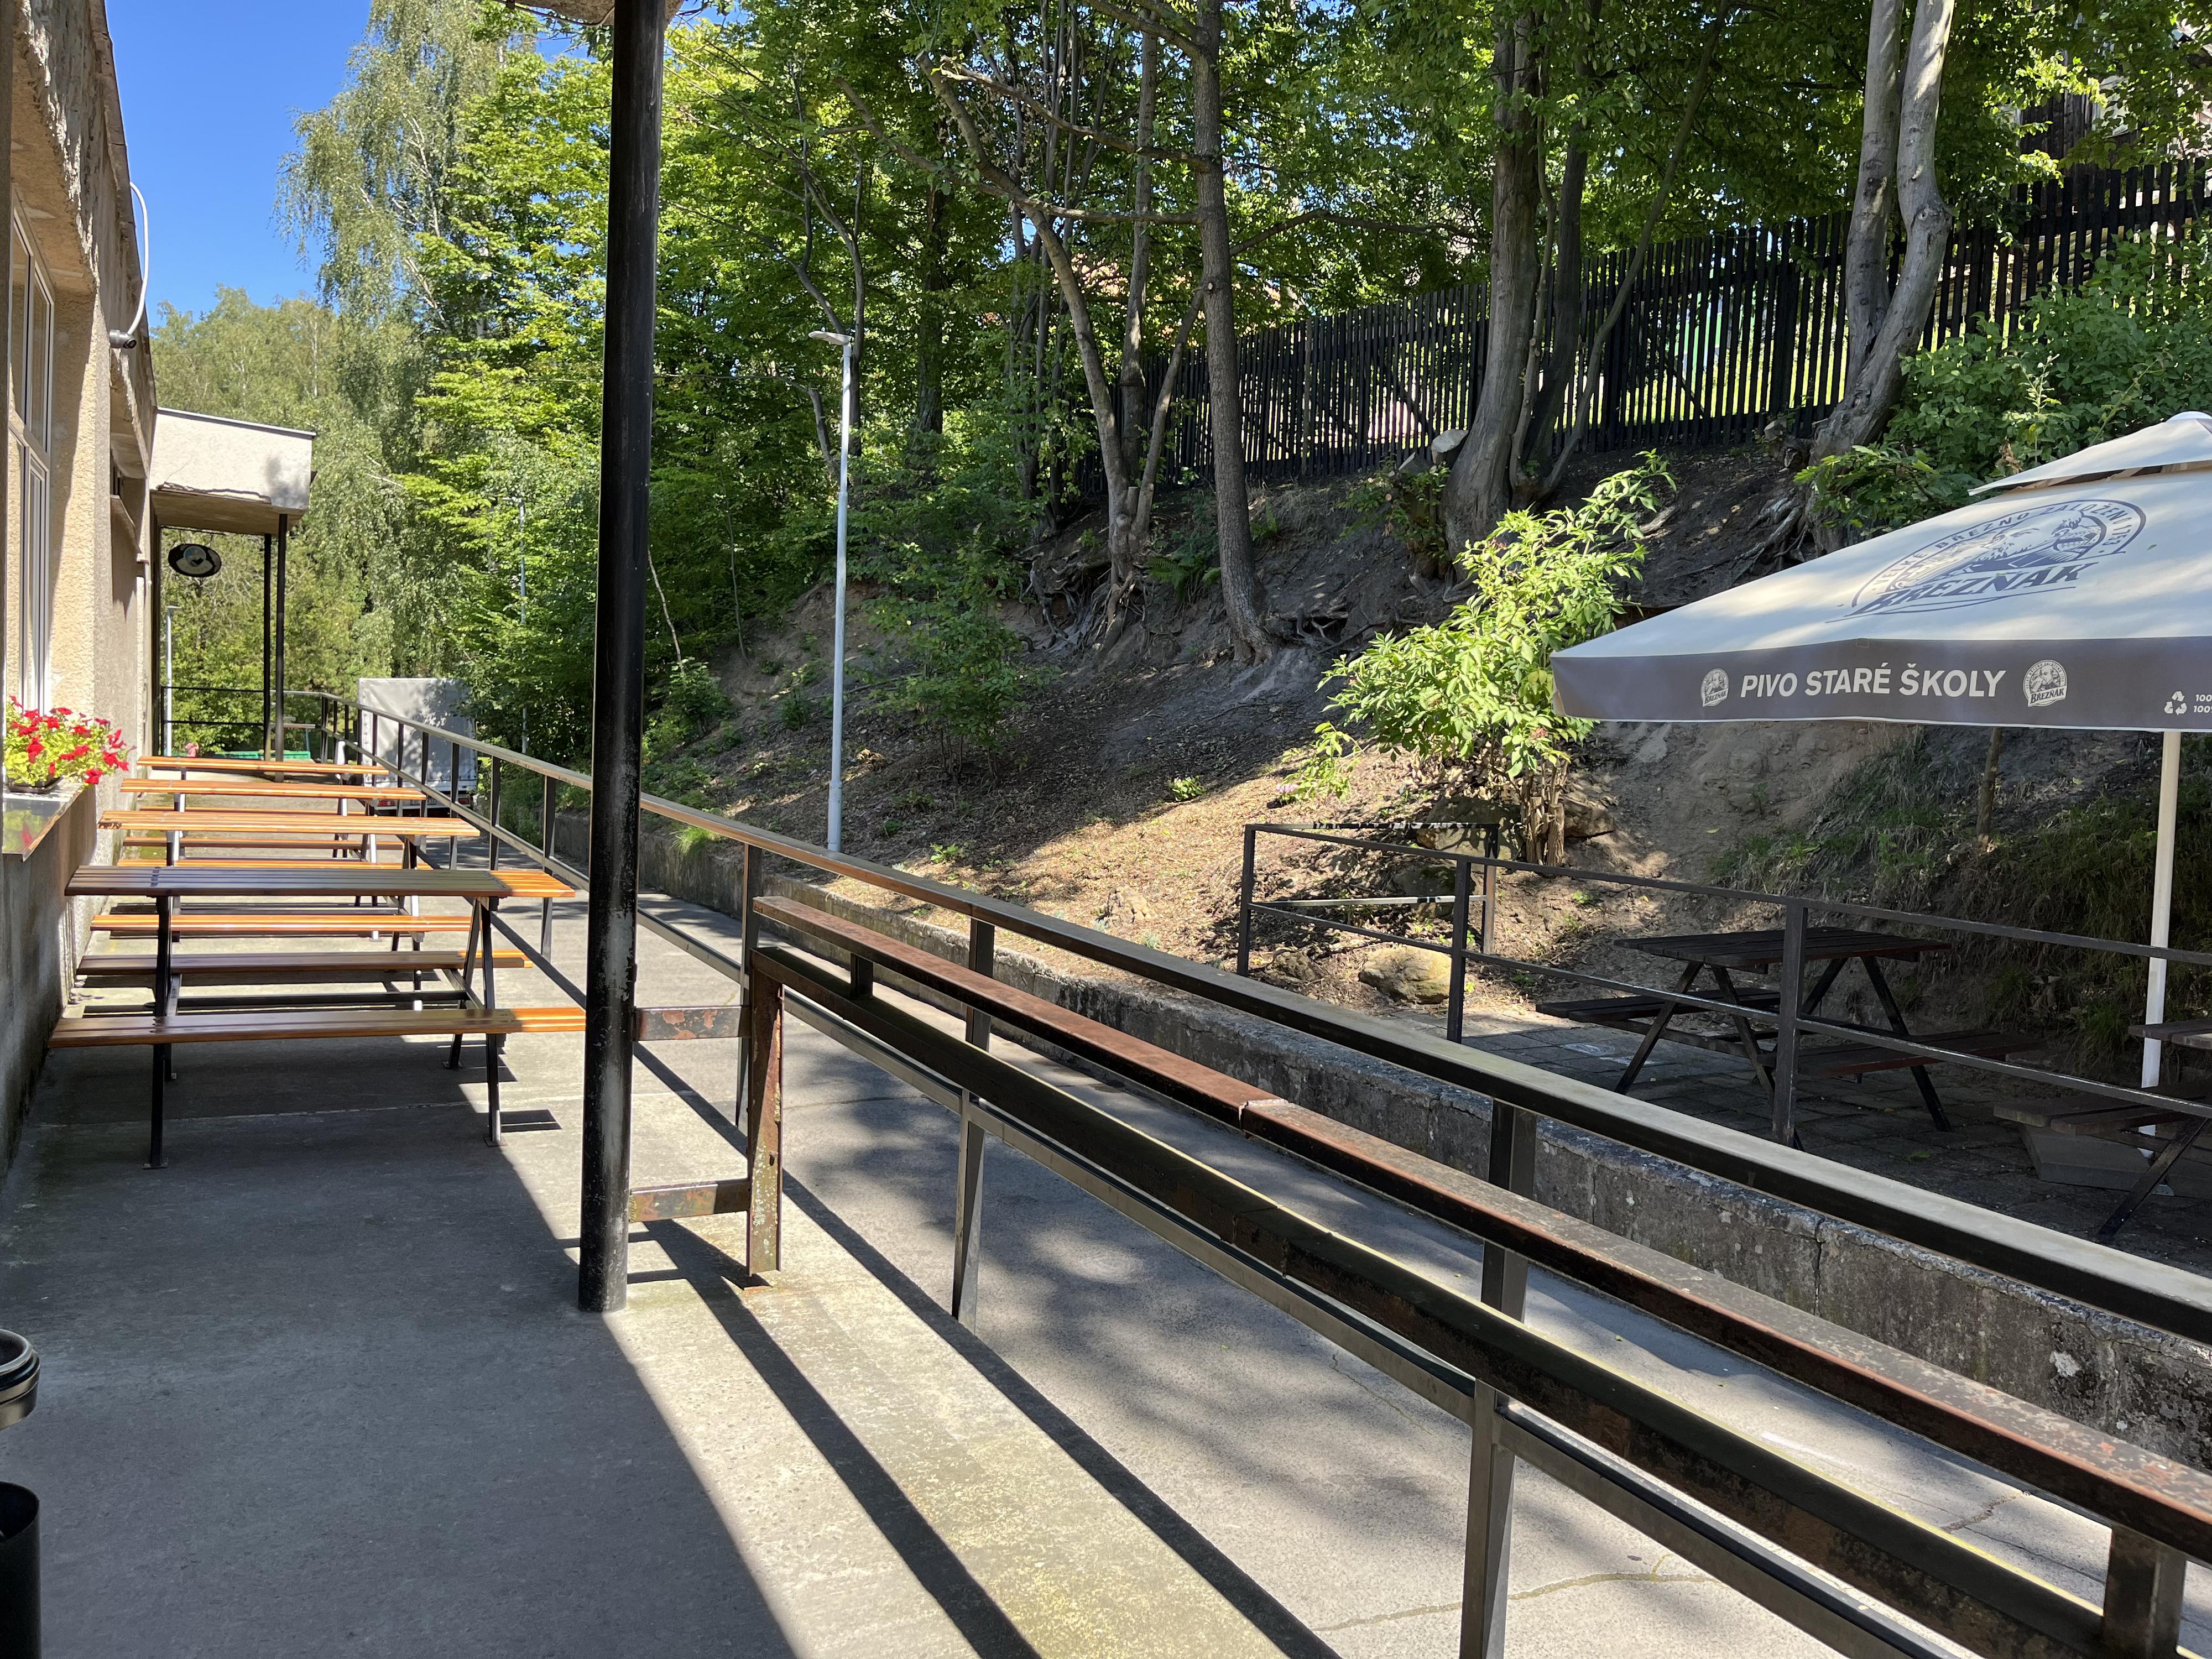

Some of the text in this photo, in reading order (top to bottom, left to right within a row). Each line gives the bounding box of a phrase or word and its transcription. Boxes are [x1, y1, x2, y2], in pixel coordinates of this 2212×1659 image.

[1741, 672, 1798, 697] PIVO
[1804, 662, 1891, 696] STARÉ
[1899, 663, 2007, 697] ŠKOLY
